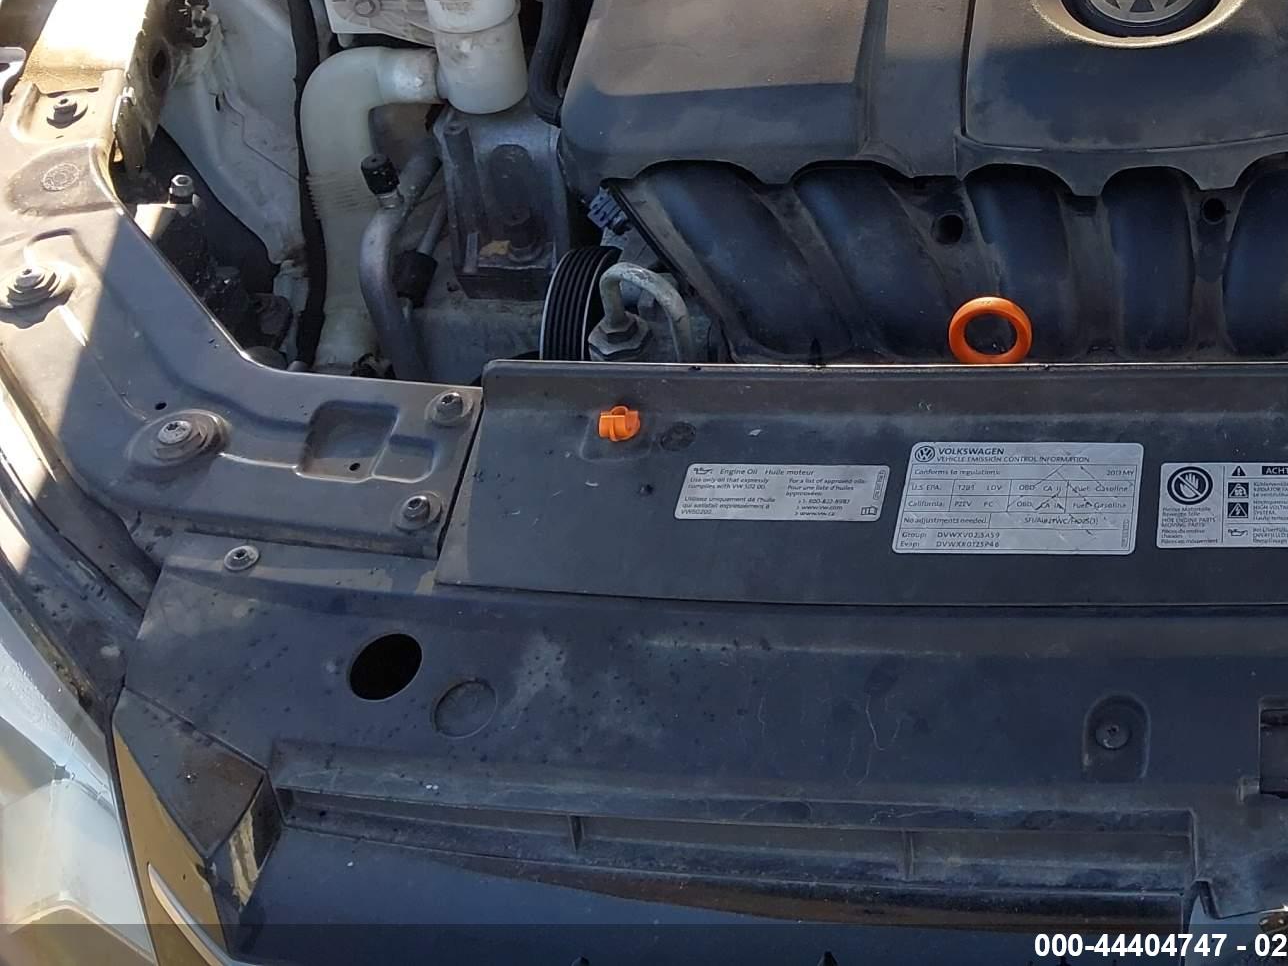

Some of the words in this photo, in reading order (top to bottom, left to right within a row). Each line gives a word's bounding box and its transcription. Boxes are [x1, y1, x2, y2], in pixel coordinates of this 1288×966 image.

[938, 447, 1005, 455] VOLKSWAGEN
[720, 468, 746, 476] Engine
[746, 468, 758, 476] Oil
[764, 468, 784, 476] Huile
[786, 468, 814, 476] moteur
[914, 468, 948, 476] Conforms
[903, 517, 915, 525] No
[916, 517, 960, 525] adjustments
